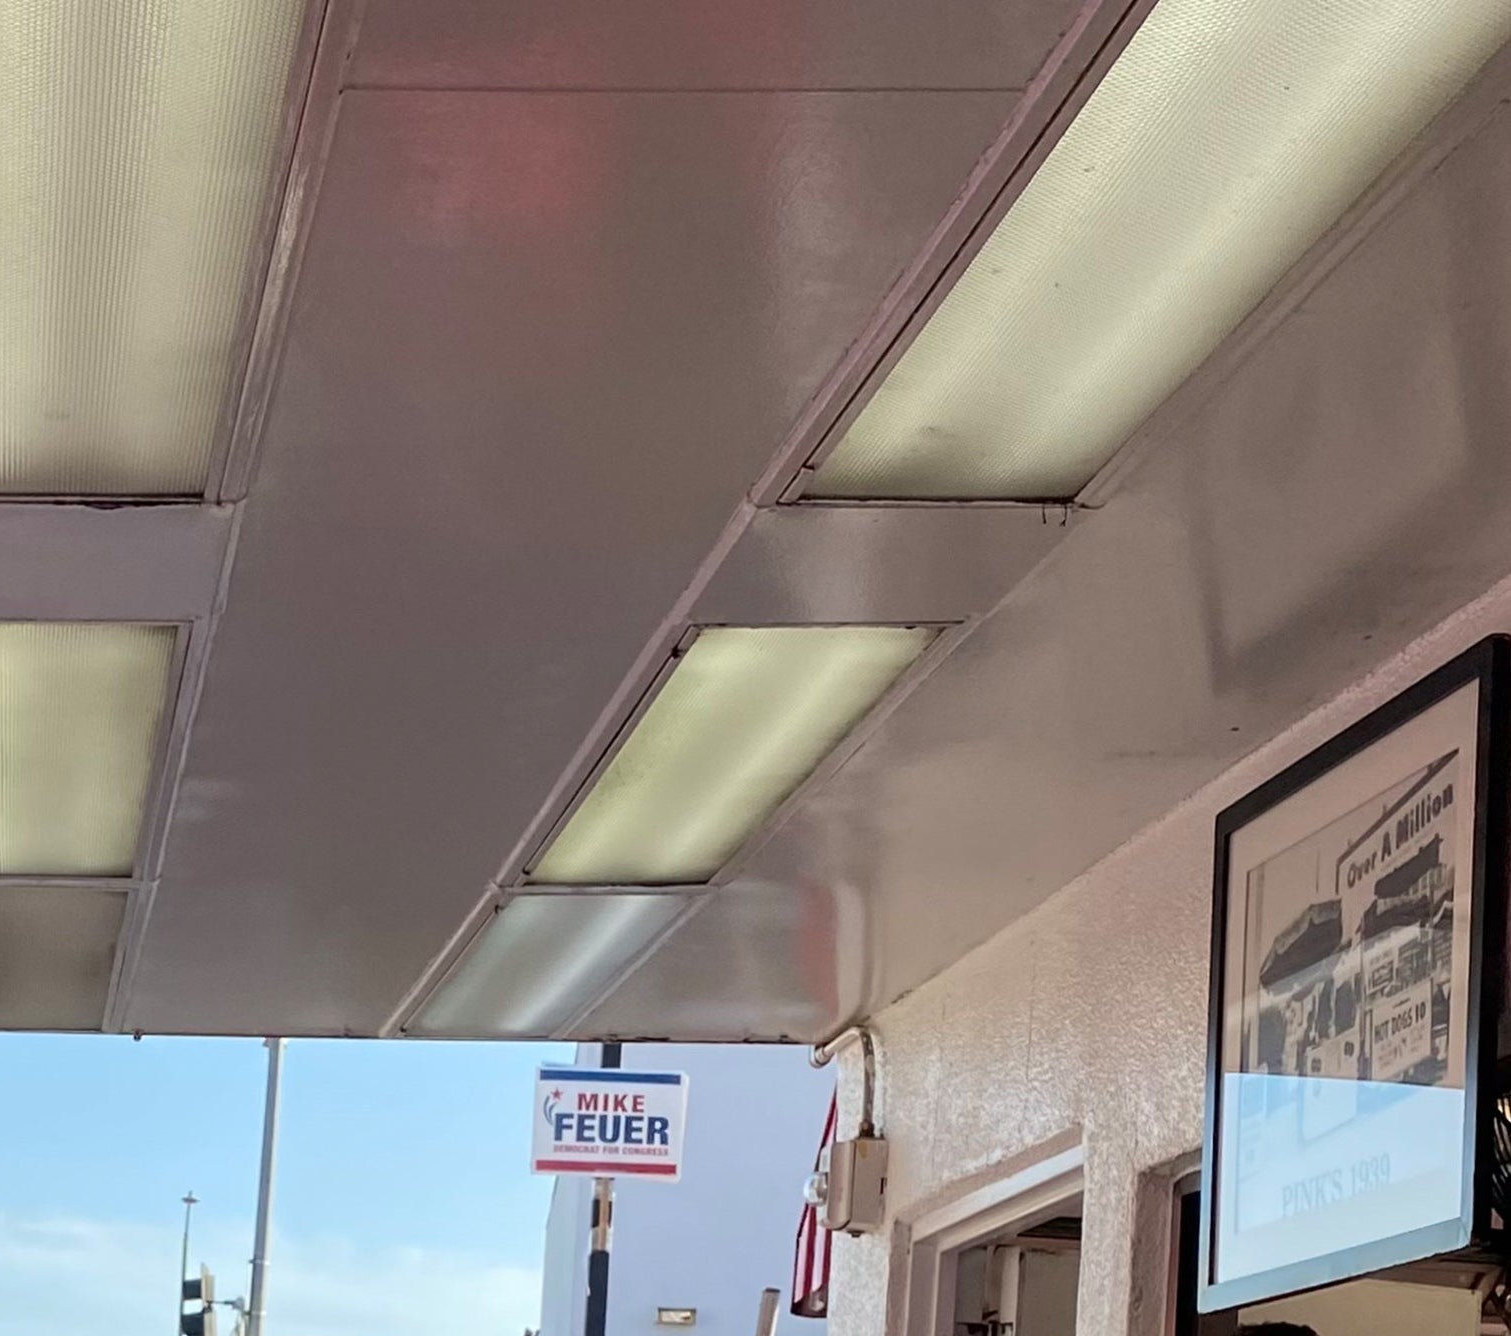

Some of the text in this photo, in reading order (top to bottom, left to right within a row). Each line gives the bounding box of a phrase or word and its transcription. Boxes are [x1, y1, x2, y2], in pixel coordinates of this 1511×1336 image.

[1381, 831, 1392, 863] A
[1396, 783, 1453, 850] Million
[1391, 1007, 1413, 1036] DOGS
[577, 1093, 646, 1114] MIKE
[553, 1113, 670, 1146] FEUER
[553, 1144, 669, 1157] DEMOCRAT FOR CONGRESS
[1281, 1151, 1392, 1217] PINK'S 1939
